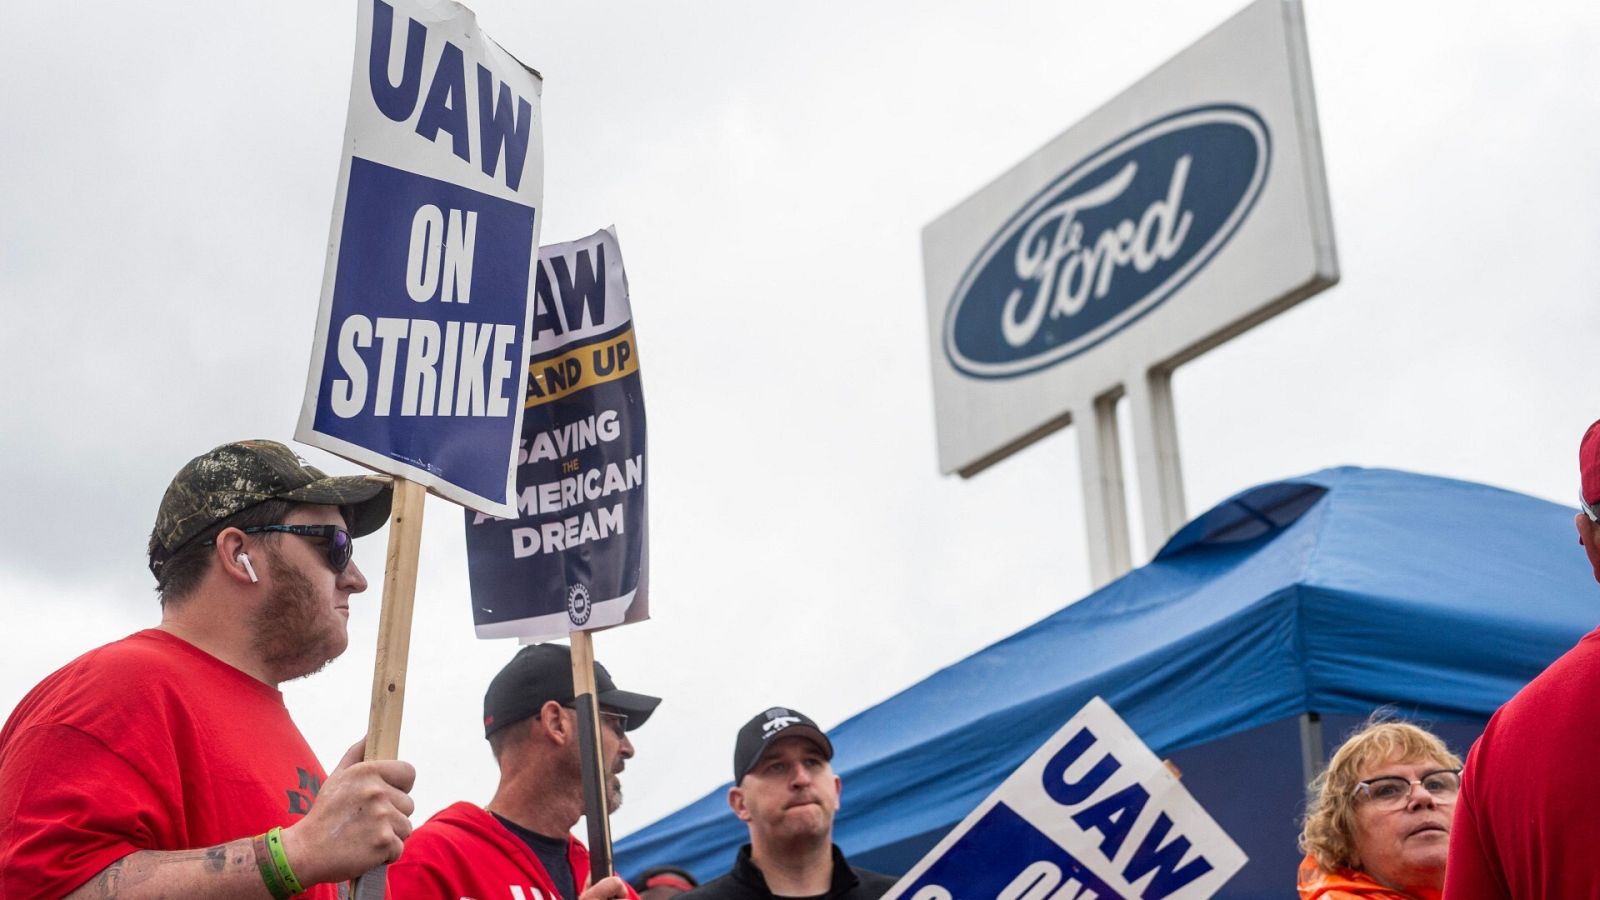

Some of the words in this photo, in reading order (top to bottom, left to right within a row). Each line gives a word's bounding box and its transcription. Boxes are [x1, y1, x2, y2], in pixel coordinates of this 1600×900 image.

[369, 0, 532, 193] UAW
[405, 204, 478, 304] ON
[532, 242, 606, 341] AW
[1002, 154, 1193, 348] Ford
[330, 314, 516, 418] STRIKE
[525, 357, 582, 403] AND
[593, 340, 631, 377] UP
[472, 454, 643, 525] MERICAN
[562, 458, 580, 473] THE
[512, 503, 624, 559] DREAM
[1042, 726, 1214, 900] UAW
